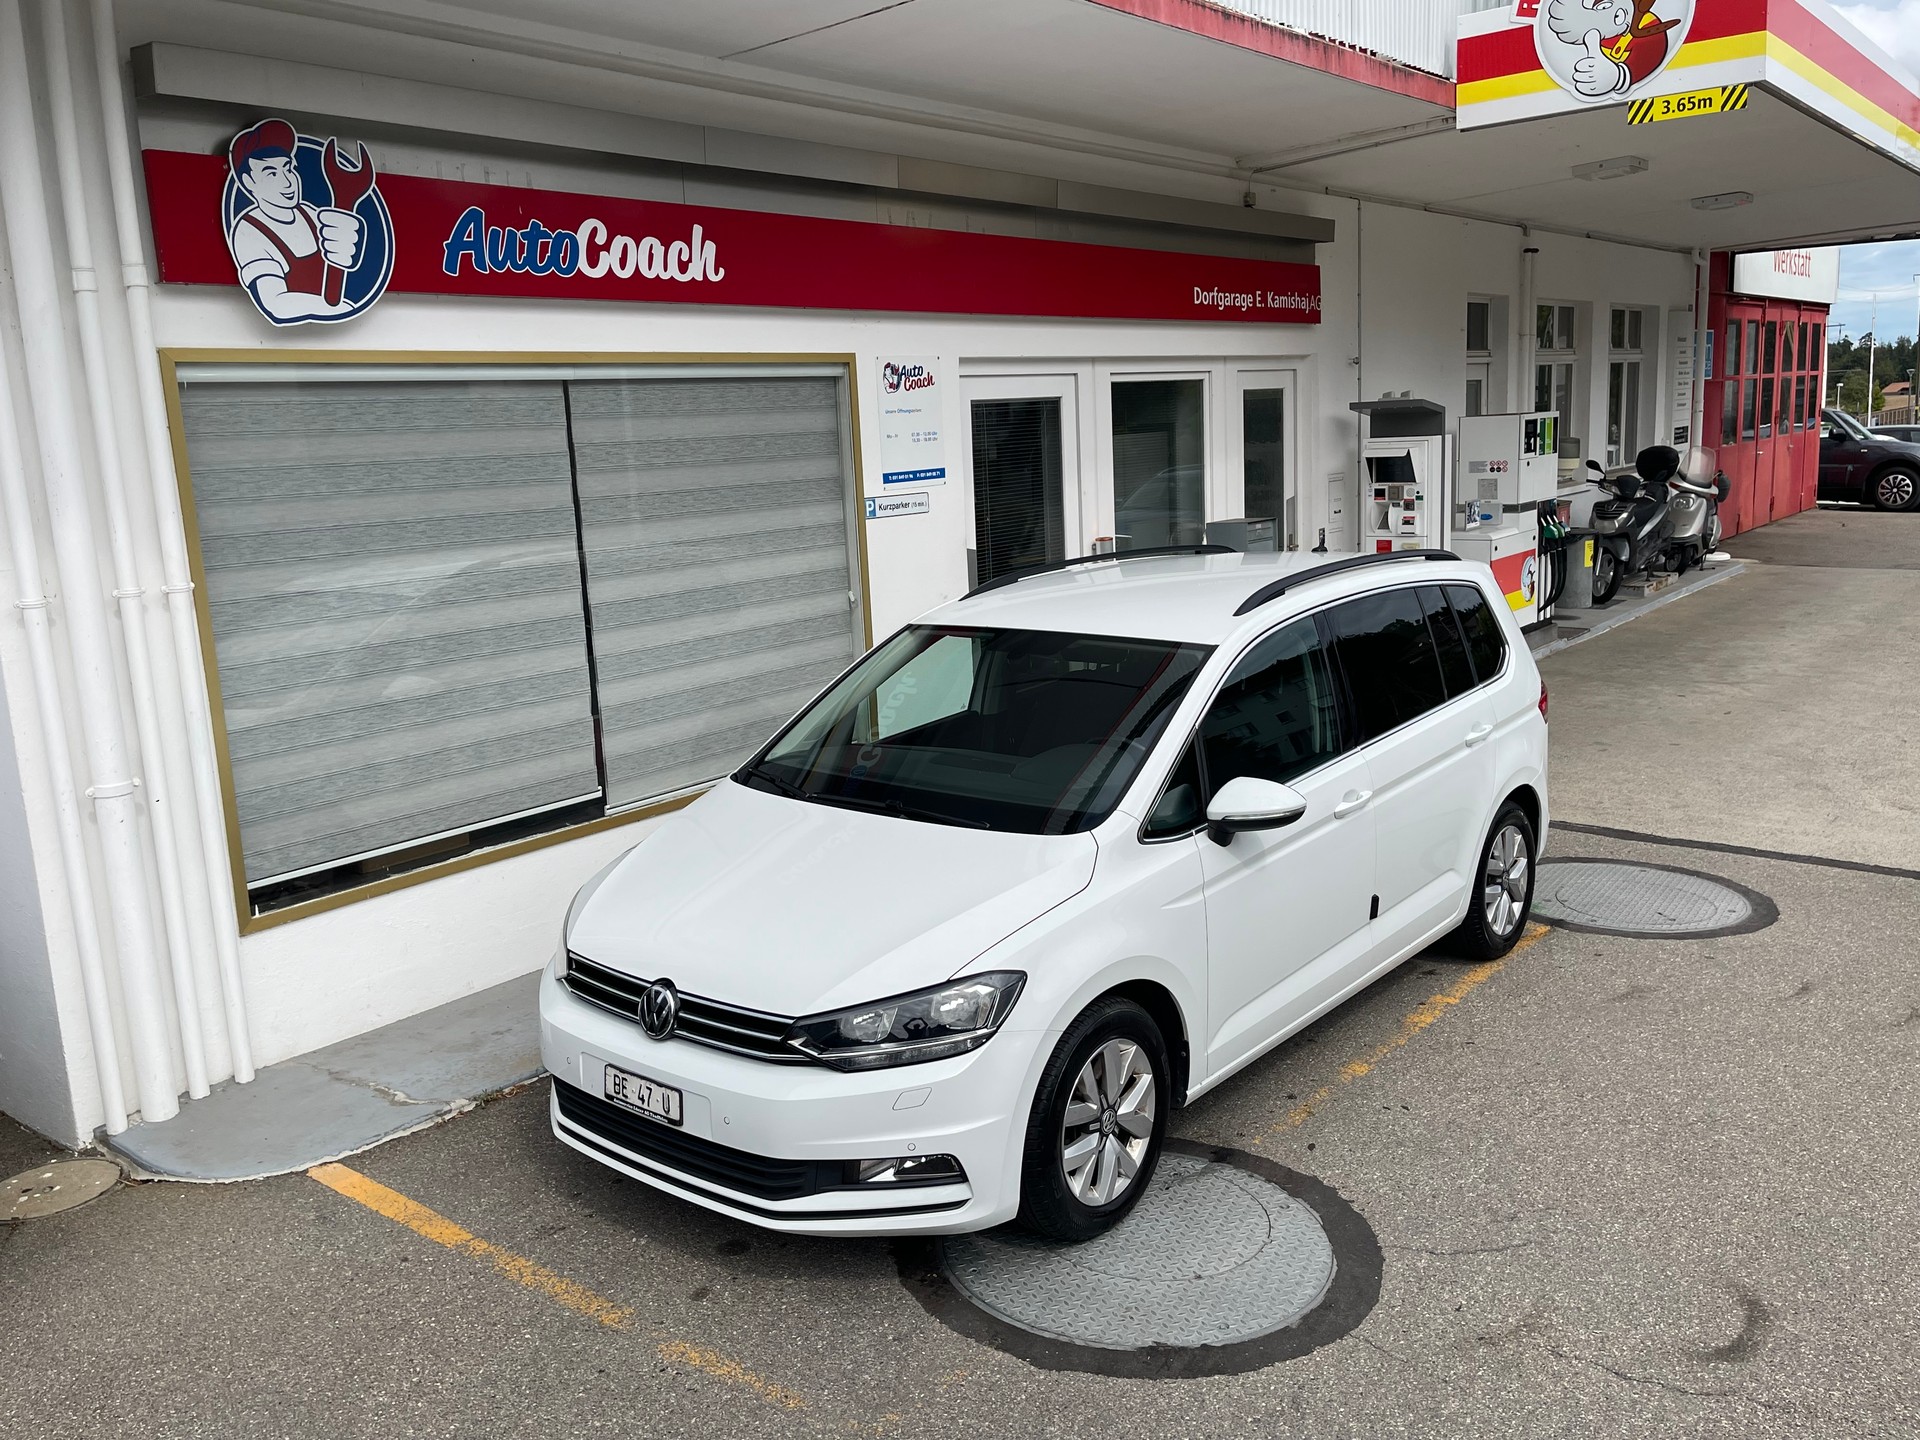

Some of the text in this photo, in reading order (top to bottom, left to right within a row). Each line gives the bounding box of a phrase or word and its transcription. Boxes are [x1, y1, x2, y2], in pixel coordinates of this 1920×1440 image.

[1661, 96, 1713, 115] 3.65m
[442, 206, 725, 282] AutoCoach
[1773, 249, 1811, 278] Werkstatt
[1194, 287, 1253, 311] Dorfgarage
[1256, 290, 1265, 307] E.
[1267, 291, 1309, 314] Kamishaj
[900, 365, 923, 381] Auto
[904, 371, 935, 391] Coach
[878, 501, 910, 511] Kurzparker
[613, 1073, 628, 1098] BE
[637, 1083, 653, 1107] 47
[661, 1092, 671, 1115] U
